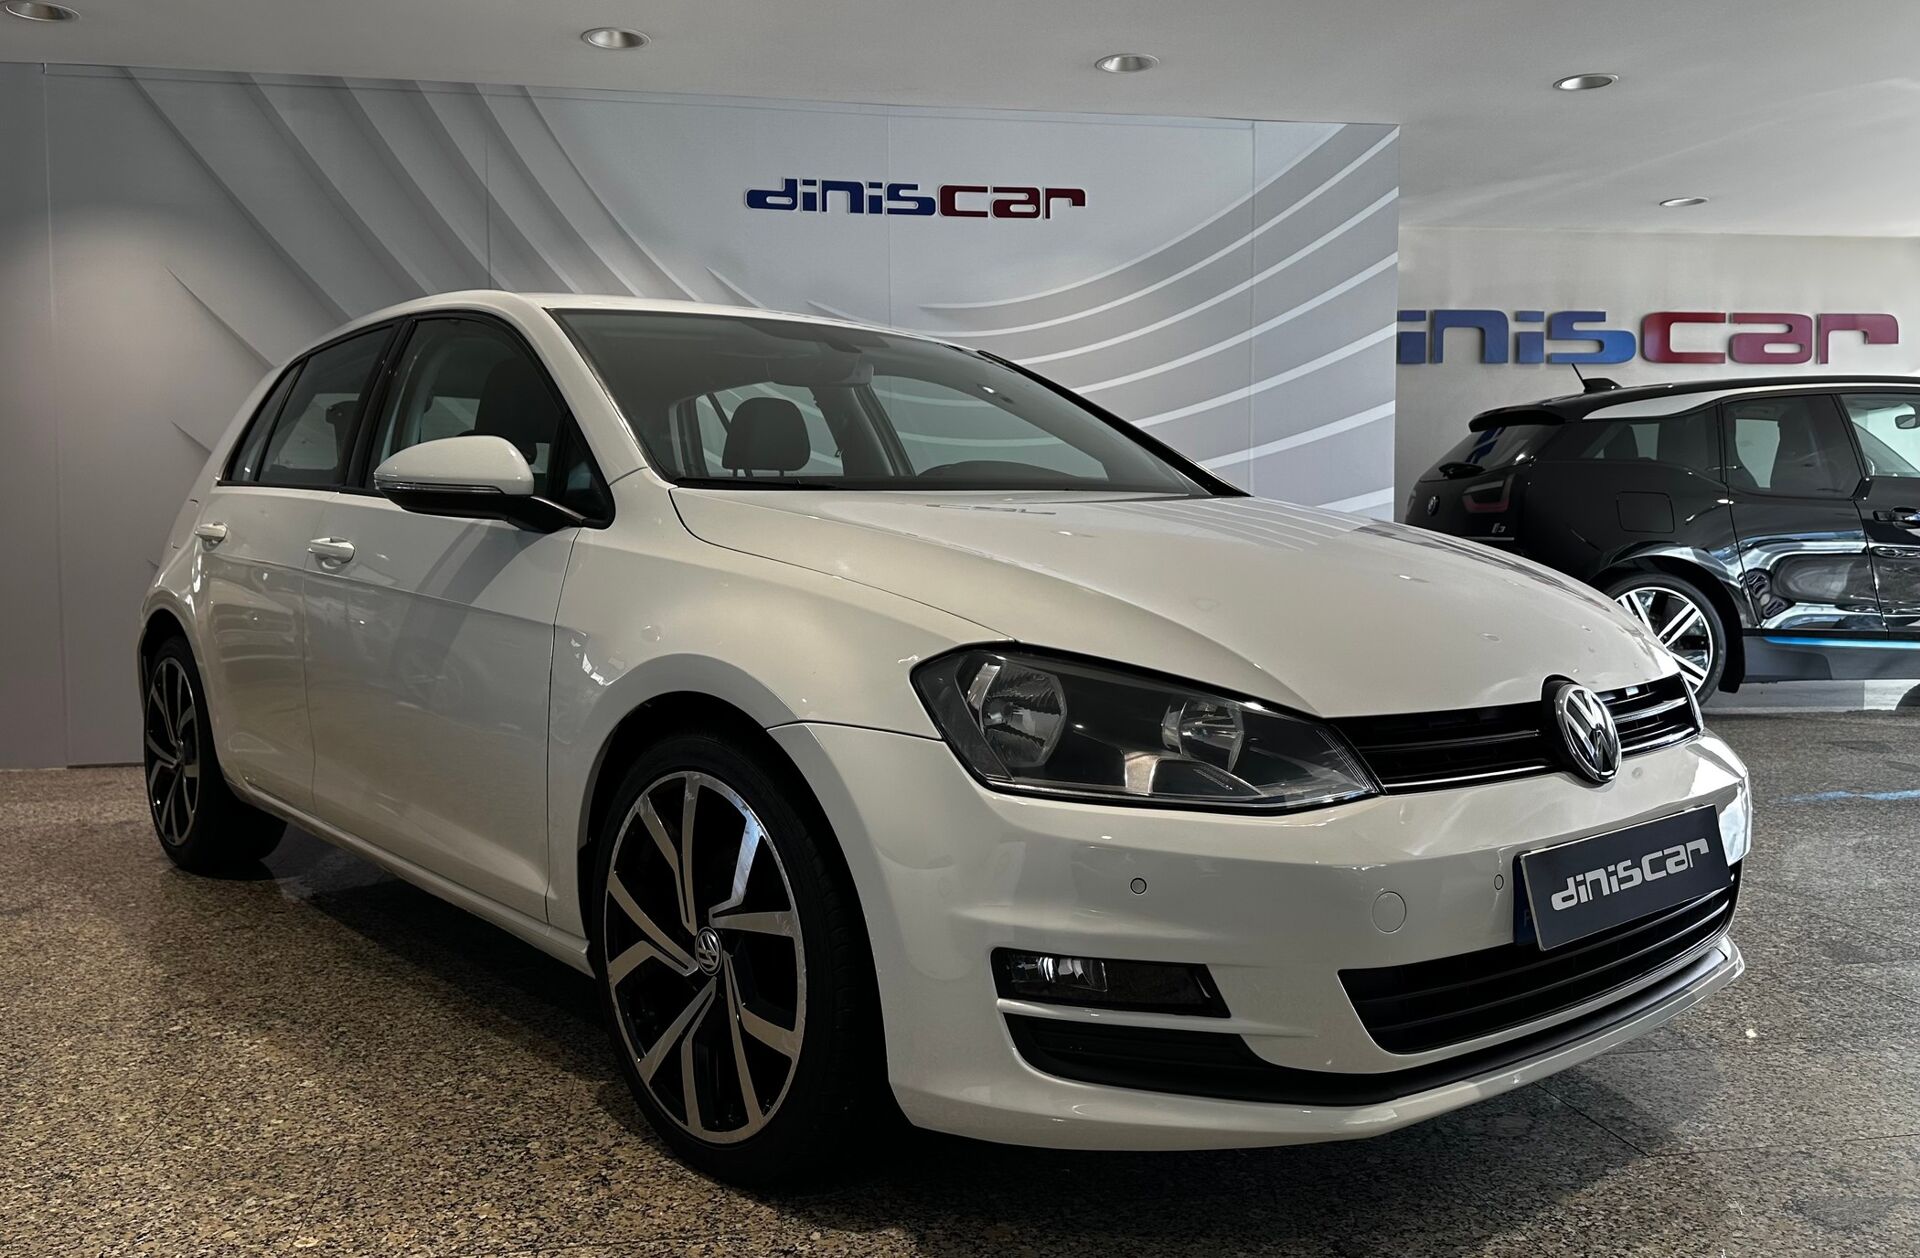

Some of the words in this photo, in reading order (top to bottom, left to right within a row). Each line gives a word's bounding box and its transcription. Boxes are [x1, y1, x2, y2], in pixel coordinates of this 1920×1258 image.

[745, 177, 1087, 220] diniscar
[1396, 309, 1899, 365] iniscar
[1551, 837, 1710, 911] diniscar
